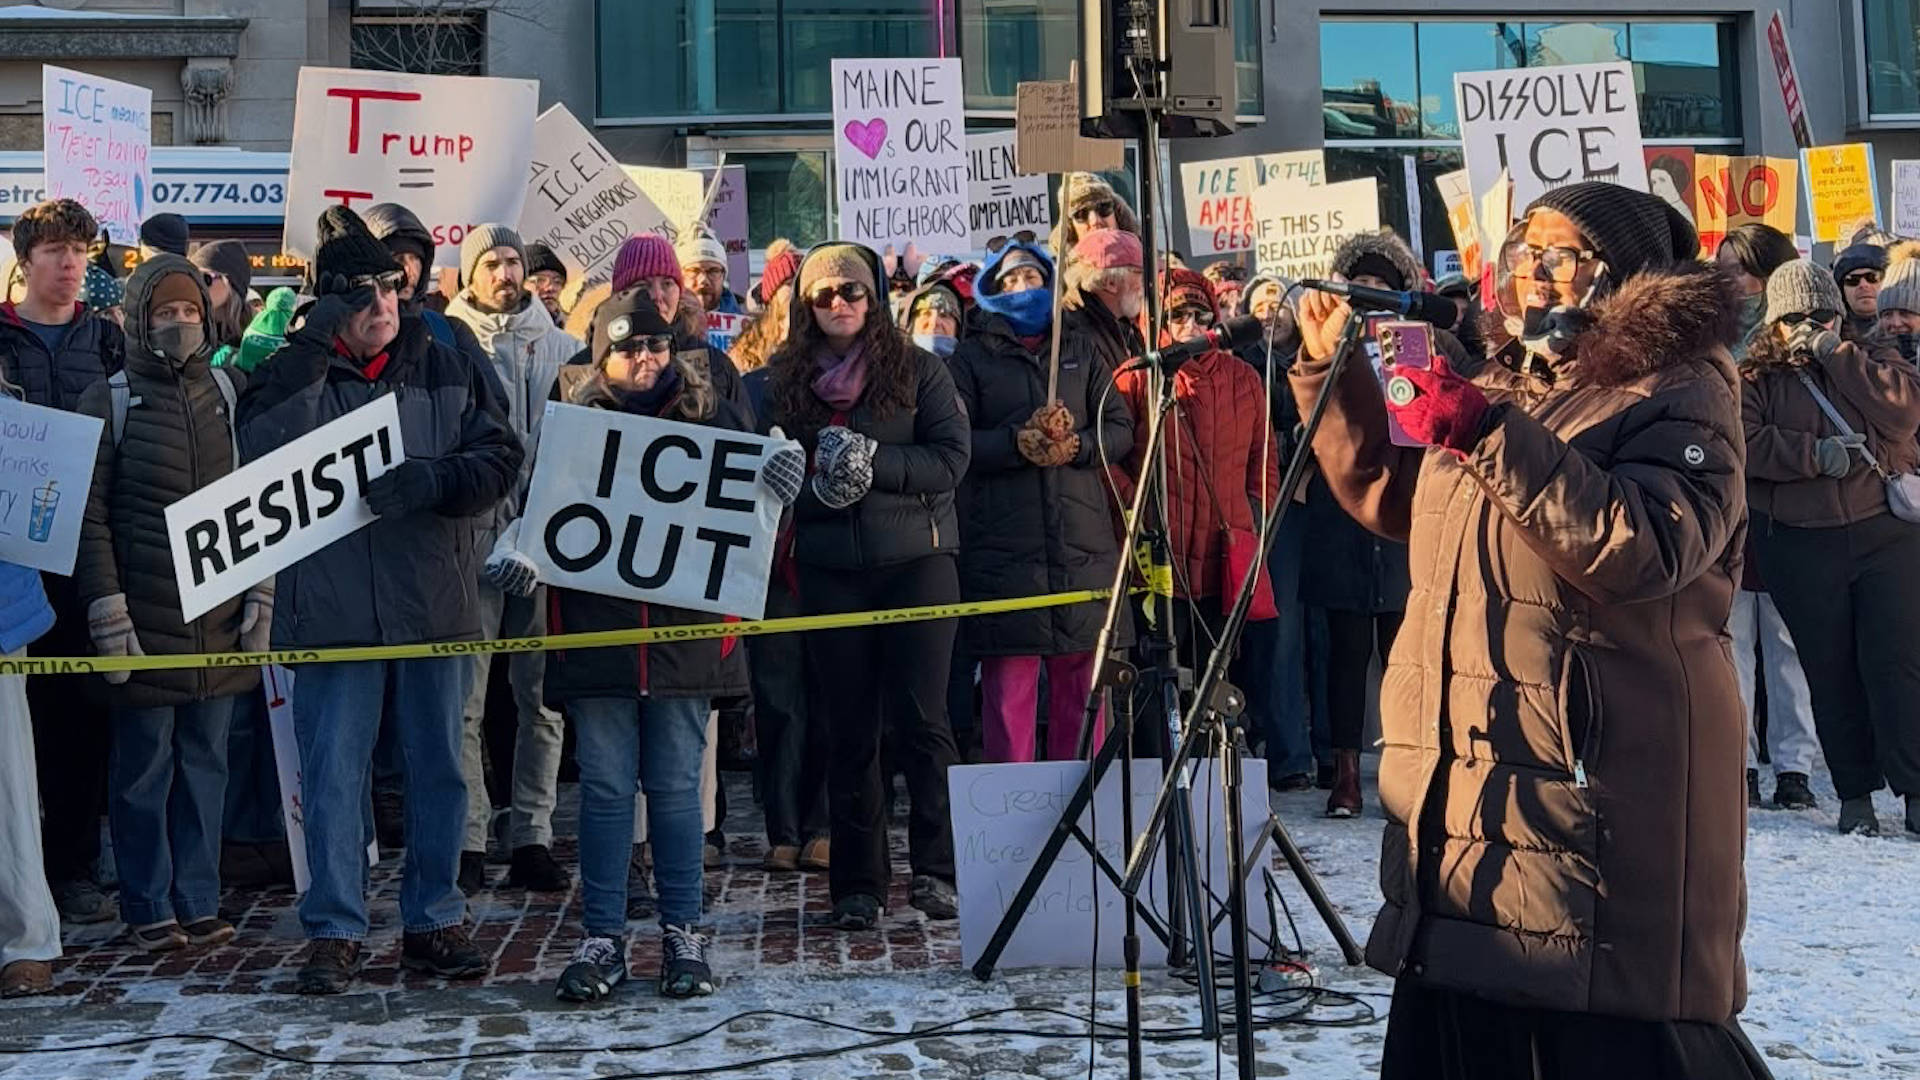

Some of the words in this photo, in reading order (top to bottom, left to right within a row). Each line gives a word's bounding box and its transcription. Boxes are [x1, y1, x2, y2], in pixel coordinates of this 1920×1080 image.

[58, 79, 105, 123] ICE
[842, 66, 944, 109] MAINE
[1461, 70, 1626, 122] DISSOLVE
[327, 88, 473, 162] Trump
[905, 119, 958, 153] OUR
[966, 144, 1037, 181] ILEN
[1198, 167, 1238, 194] ICE
[1285, 160, 1321, 187] THE
[1494, 126, 1620, 186] ICE
[844, 165, 967, 201] IMMIGRANT
[1698, 164, 1780, 220] NO
[565, 180, 637, 236] NEIGHBORS
[856, 204, 966, 239] NEIGHBORS
[970, 193, 1048, 231] OMPLIANCE
[1257, 217, 1273, 239] IF
[1280, 213, 1320, 236] THIS
[1327, 210, 1343, 231] IS
[569, 219, 628, 268] BLOOD
[1213, 223, 1253, 250] GES
[1258, 235, 1321, 263] REALLY
[0, 447, 49, 477] rinks
[596, 429, 764, 513] ICE
[544, 503, 751, 601] OUT
[969, 771, 1075, 817] Creat
